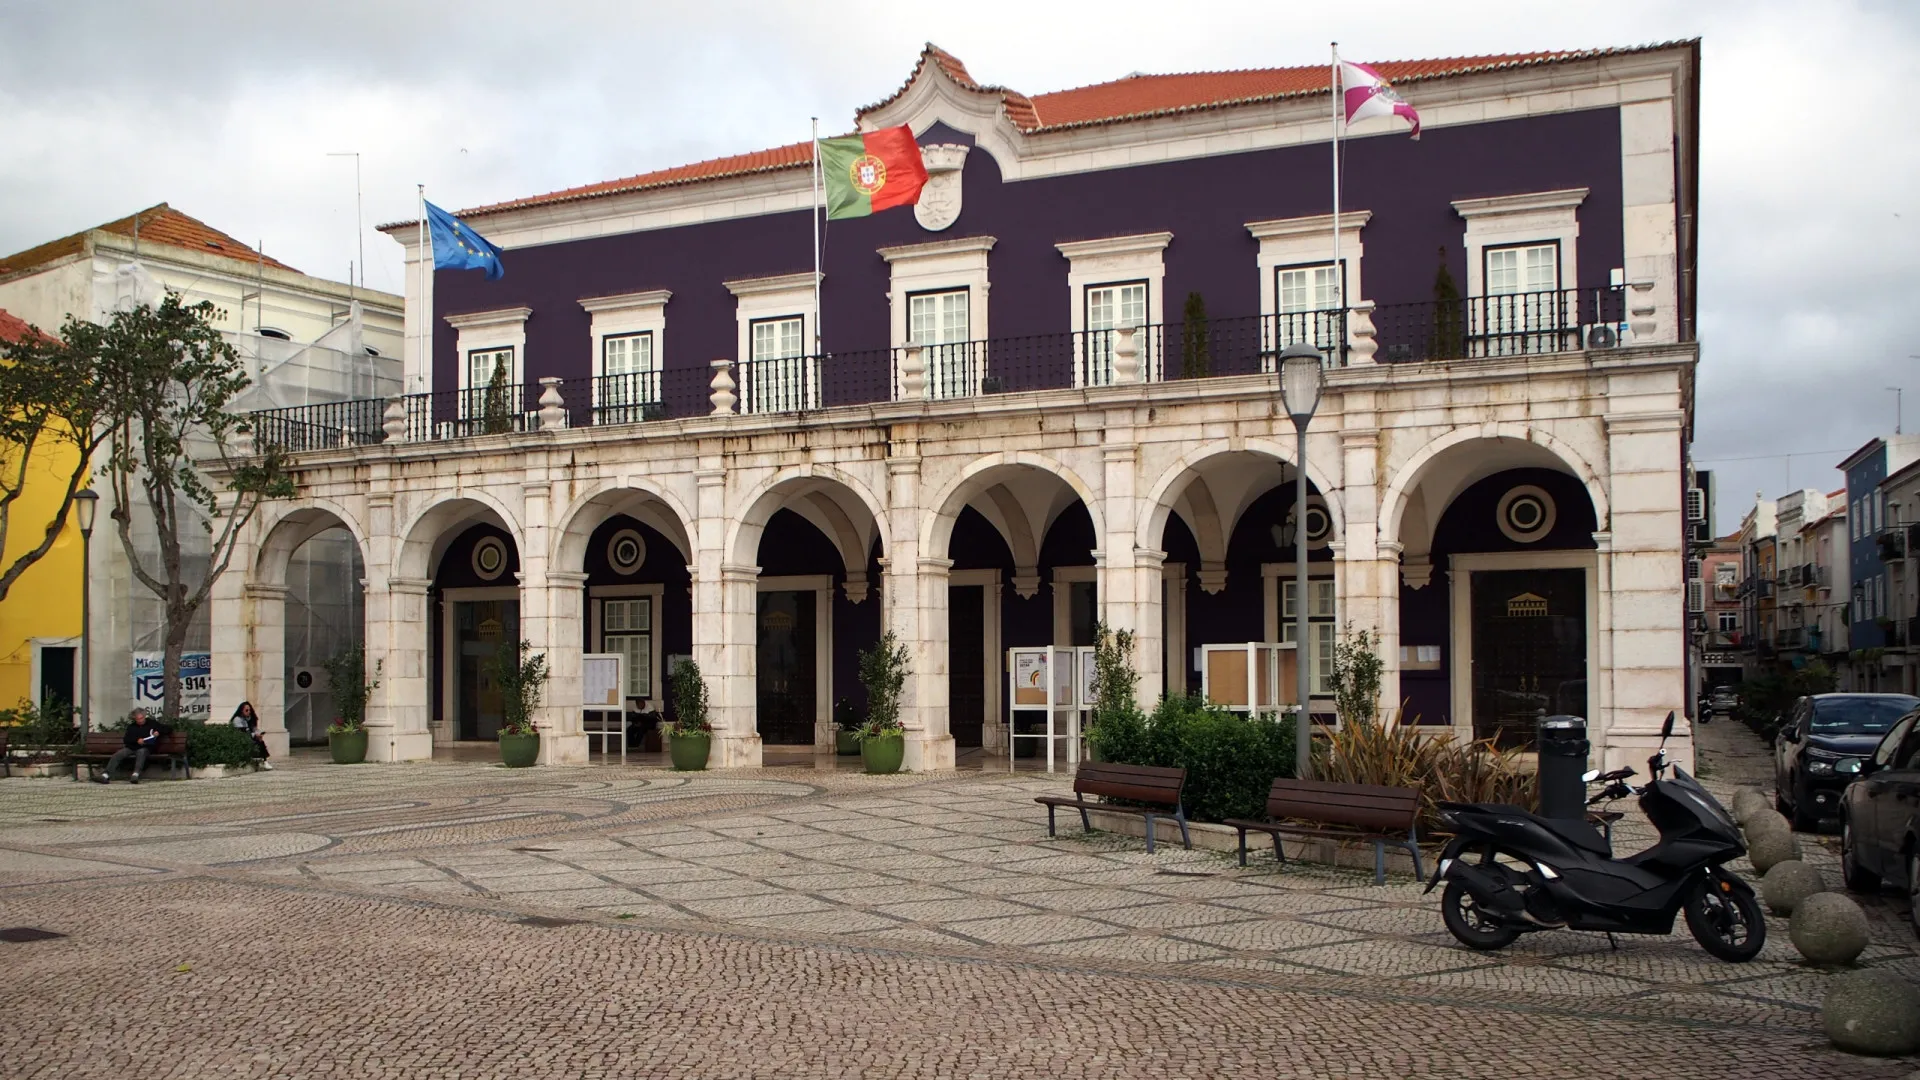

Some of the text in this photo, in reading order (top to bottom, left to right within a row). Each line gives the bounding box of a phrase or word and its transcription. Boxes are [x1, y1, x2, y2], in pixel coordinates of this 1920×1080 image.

[185, 677, 206, 690] 914
[145, 706, 163, 715] SUA
[192, 704, 204, 713] EM
